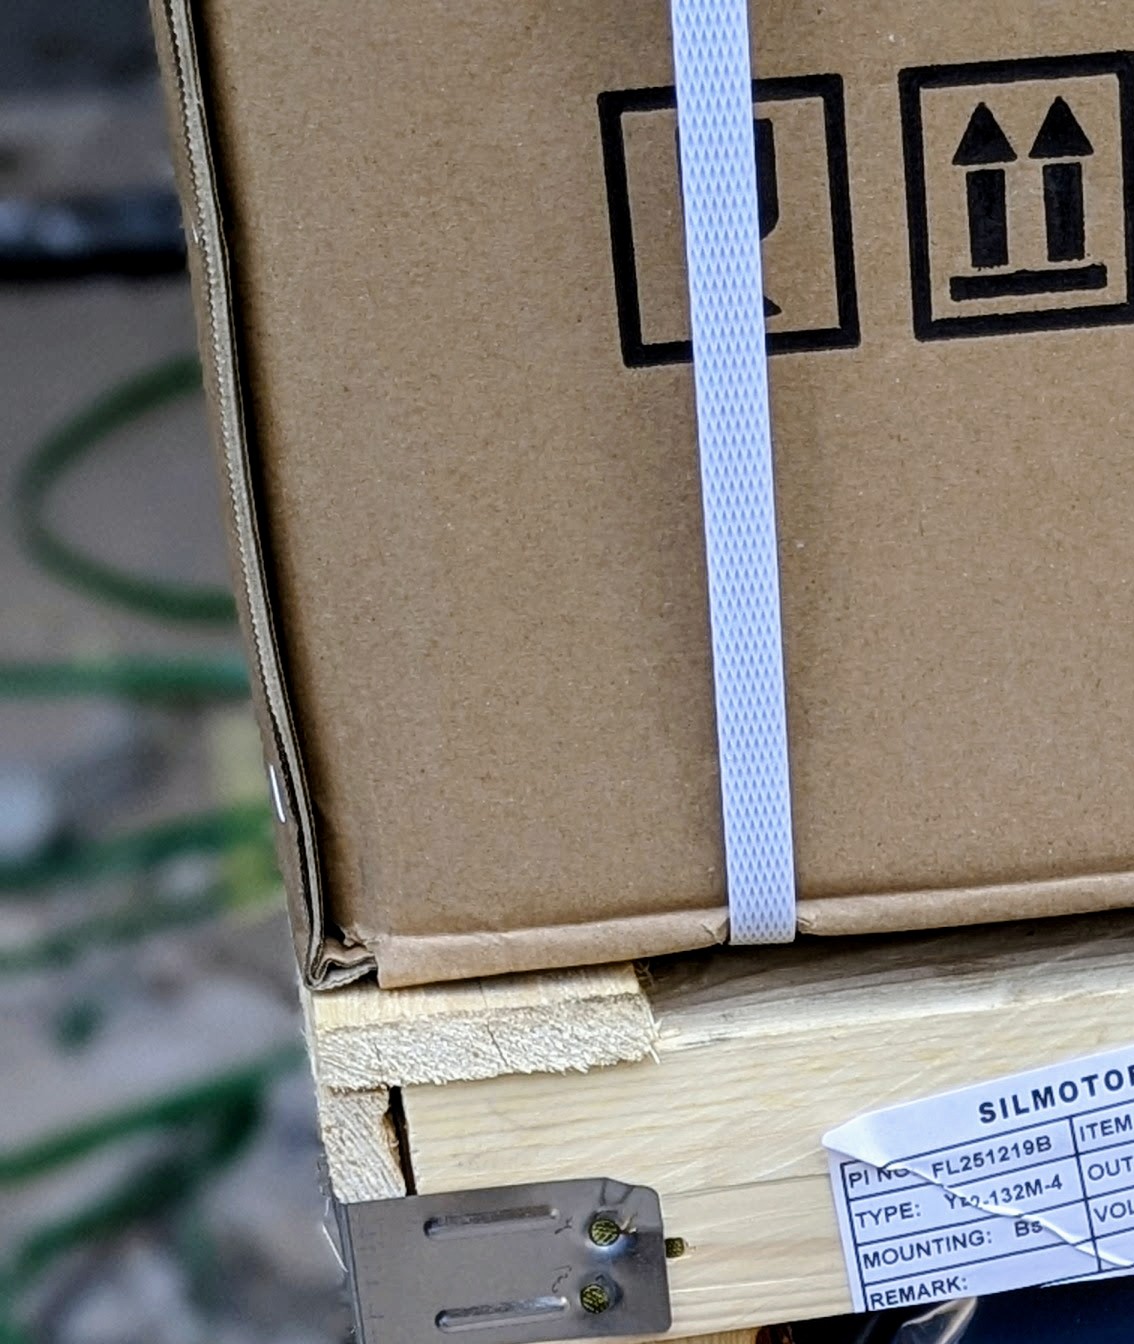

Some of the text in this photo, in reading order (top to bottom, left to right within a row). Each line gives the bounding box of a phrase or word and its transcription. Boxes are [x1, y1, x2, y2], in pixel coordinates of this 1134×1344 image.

[1080, 1114, 1132, 1142] ITEM
[849, 1169, 869, 1188] PI
[932, 1135, 1052, 1178] FL251219B
[855, 1202, 921, 1228] TYPE:
[863, 1230, 992, 1269] MOUNTING:
[870, 1276, 968, 1309] REMARK:
